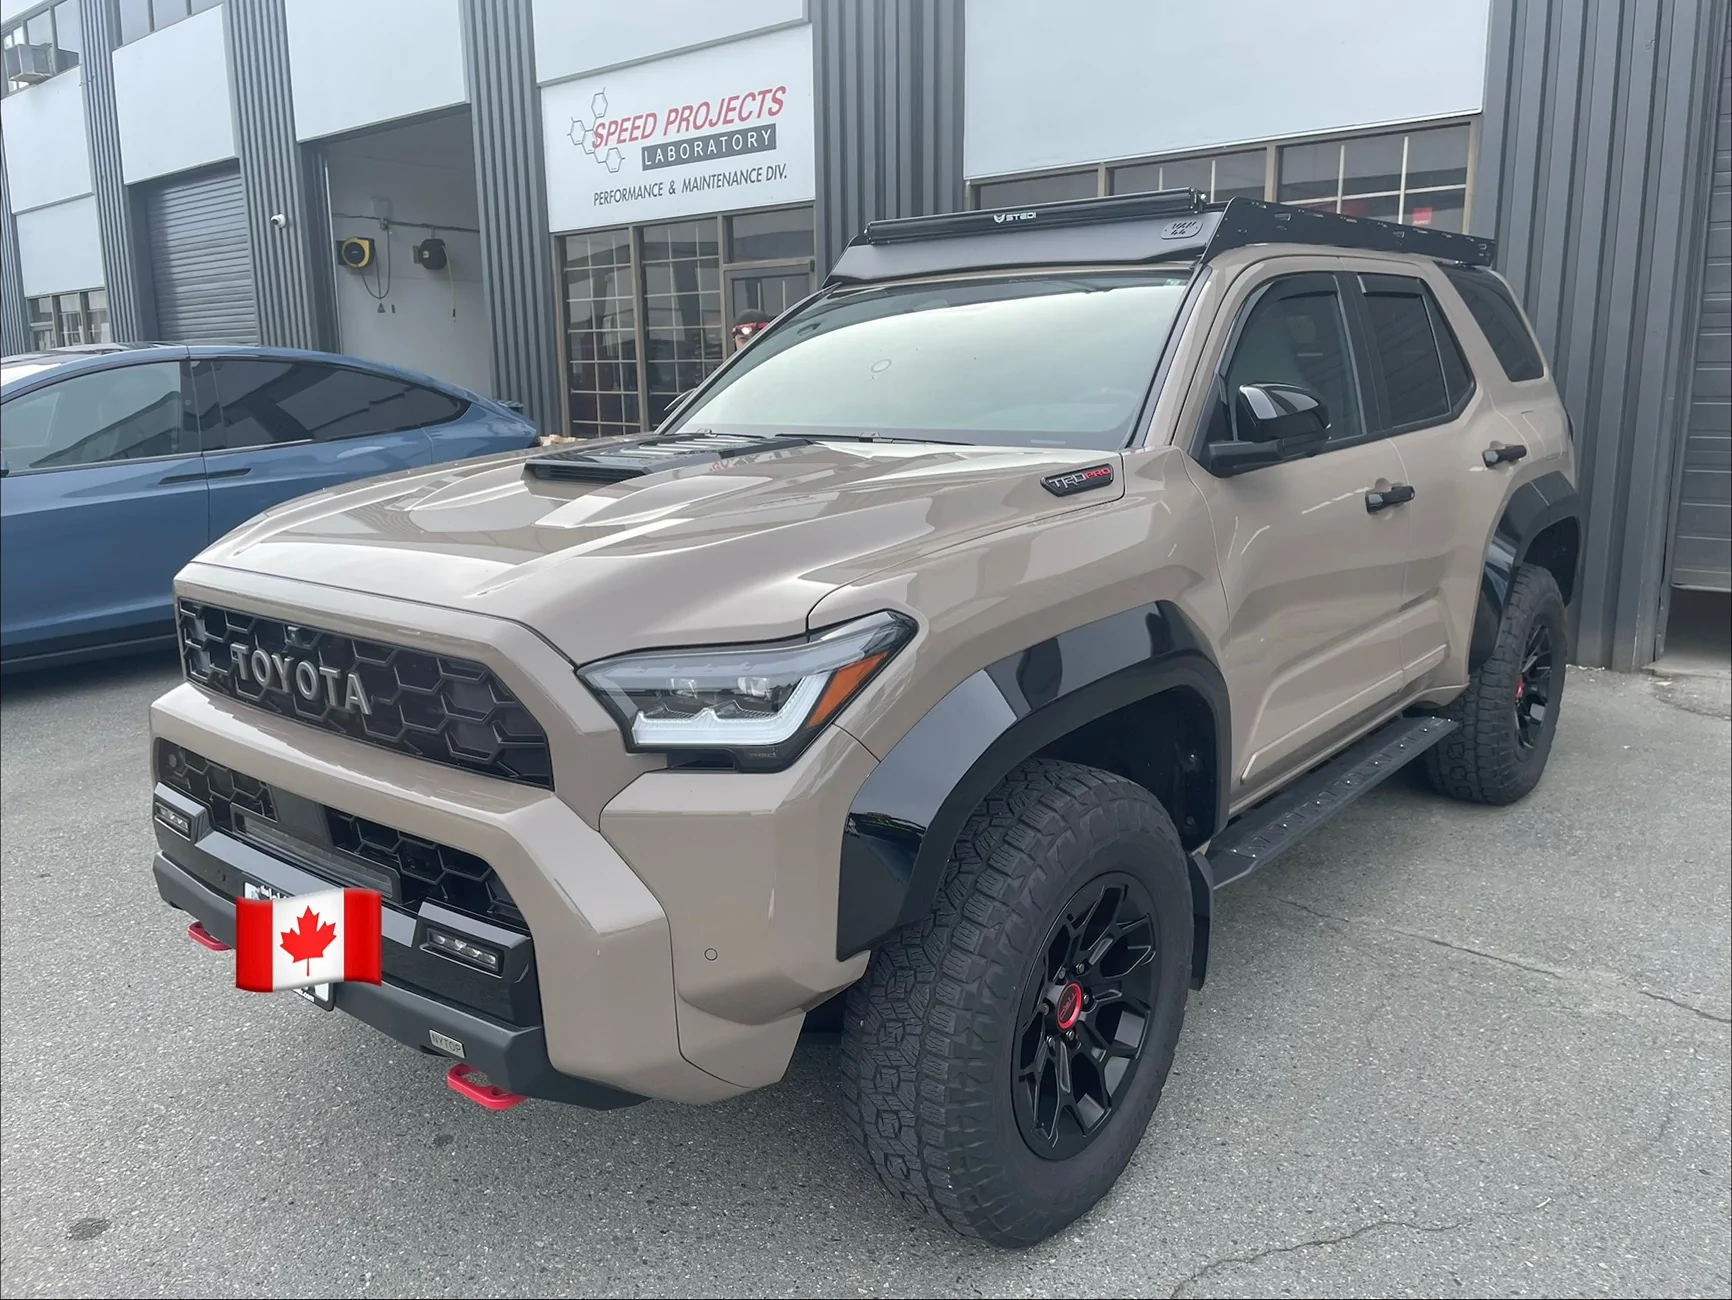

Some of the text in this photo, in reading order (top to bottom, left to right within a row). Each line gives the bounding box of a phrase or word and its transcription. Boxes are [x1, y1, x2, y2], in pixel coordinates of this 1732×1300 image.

[593, 86, 787, 149] SPEED PROJECTS
[644, 129, 772, 165] LABORATORY
[594, 163, 788, 206] PERFORMANCE & MAINTENANCE DIV.
[1006, 212, 1037, 221] STEDI
[230, 643, 372, 715] TOYOTA
